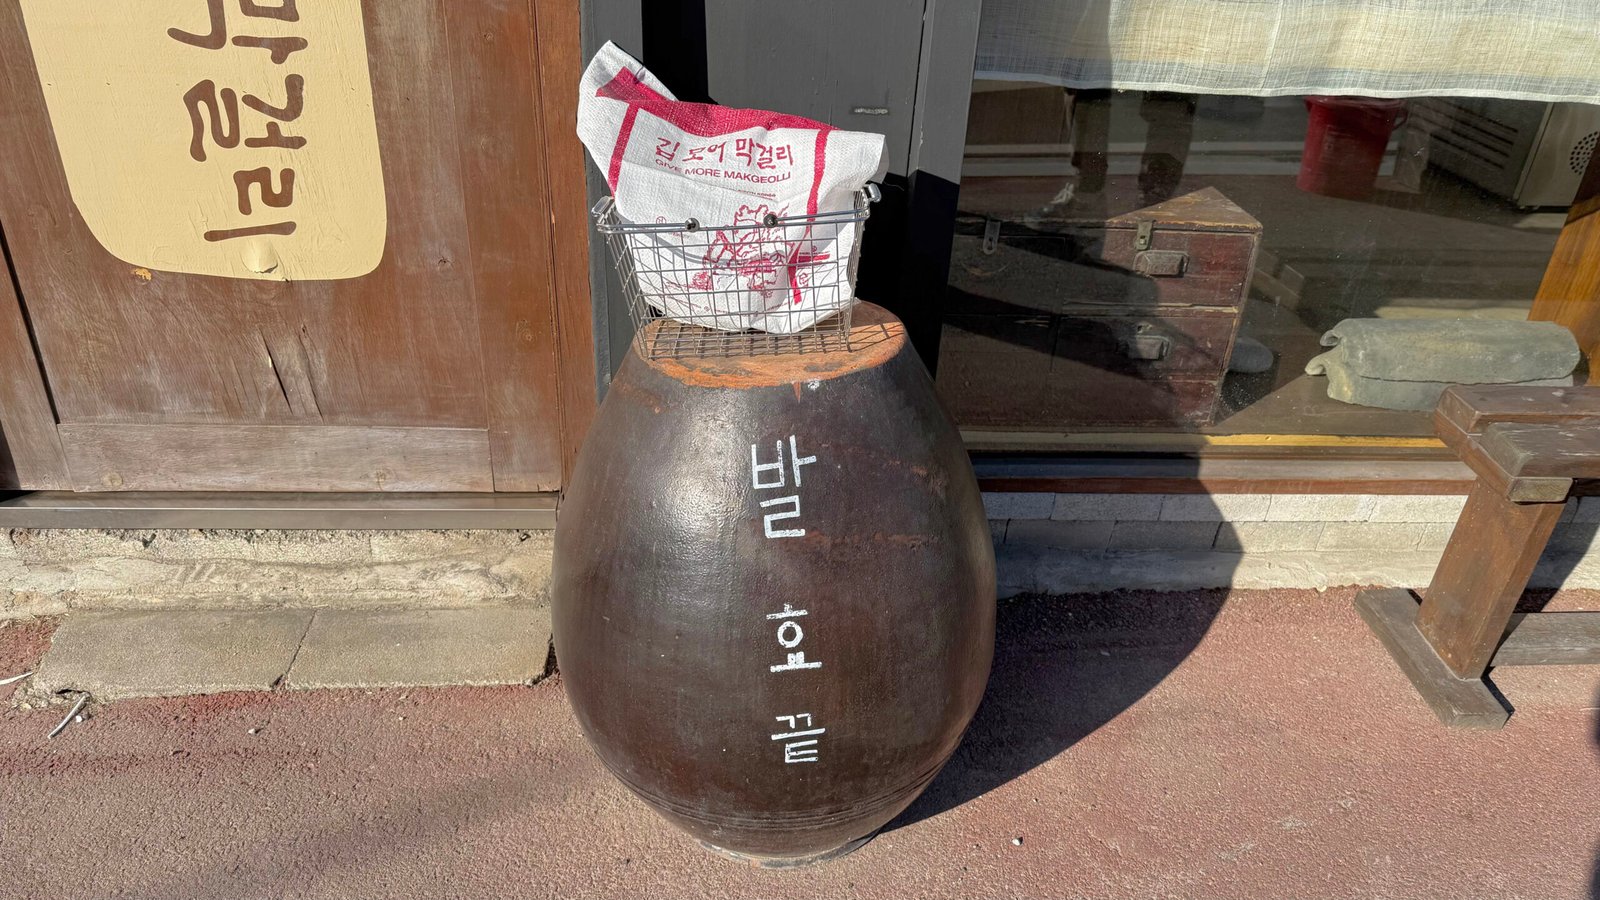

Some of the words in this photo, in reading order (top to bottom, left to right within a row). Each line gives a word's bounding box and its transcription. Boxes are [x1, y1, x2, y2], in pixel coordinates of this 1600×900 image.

[735, 137, 794, 169] 막걸리
[655, 158, 683, 172] GIVE
[684, 167, 721, 178] MORE
[723, 170, 791, 184] MAKGEOLLI
[771, 713, 826, 763] 끝
